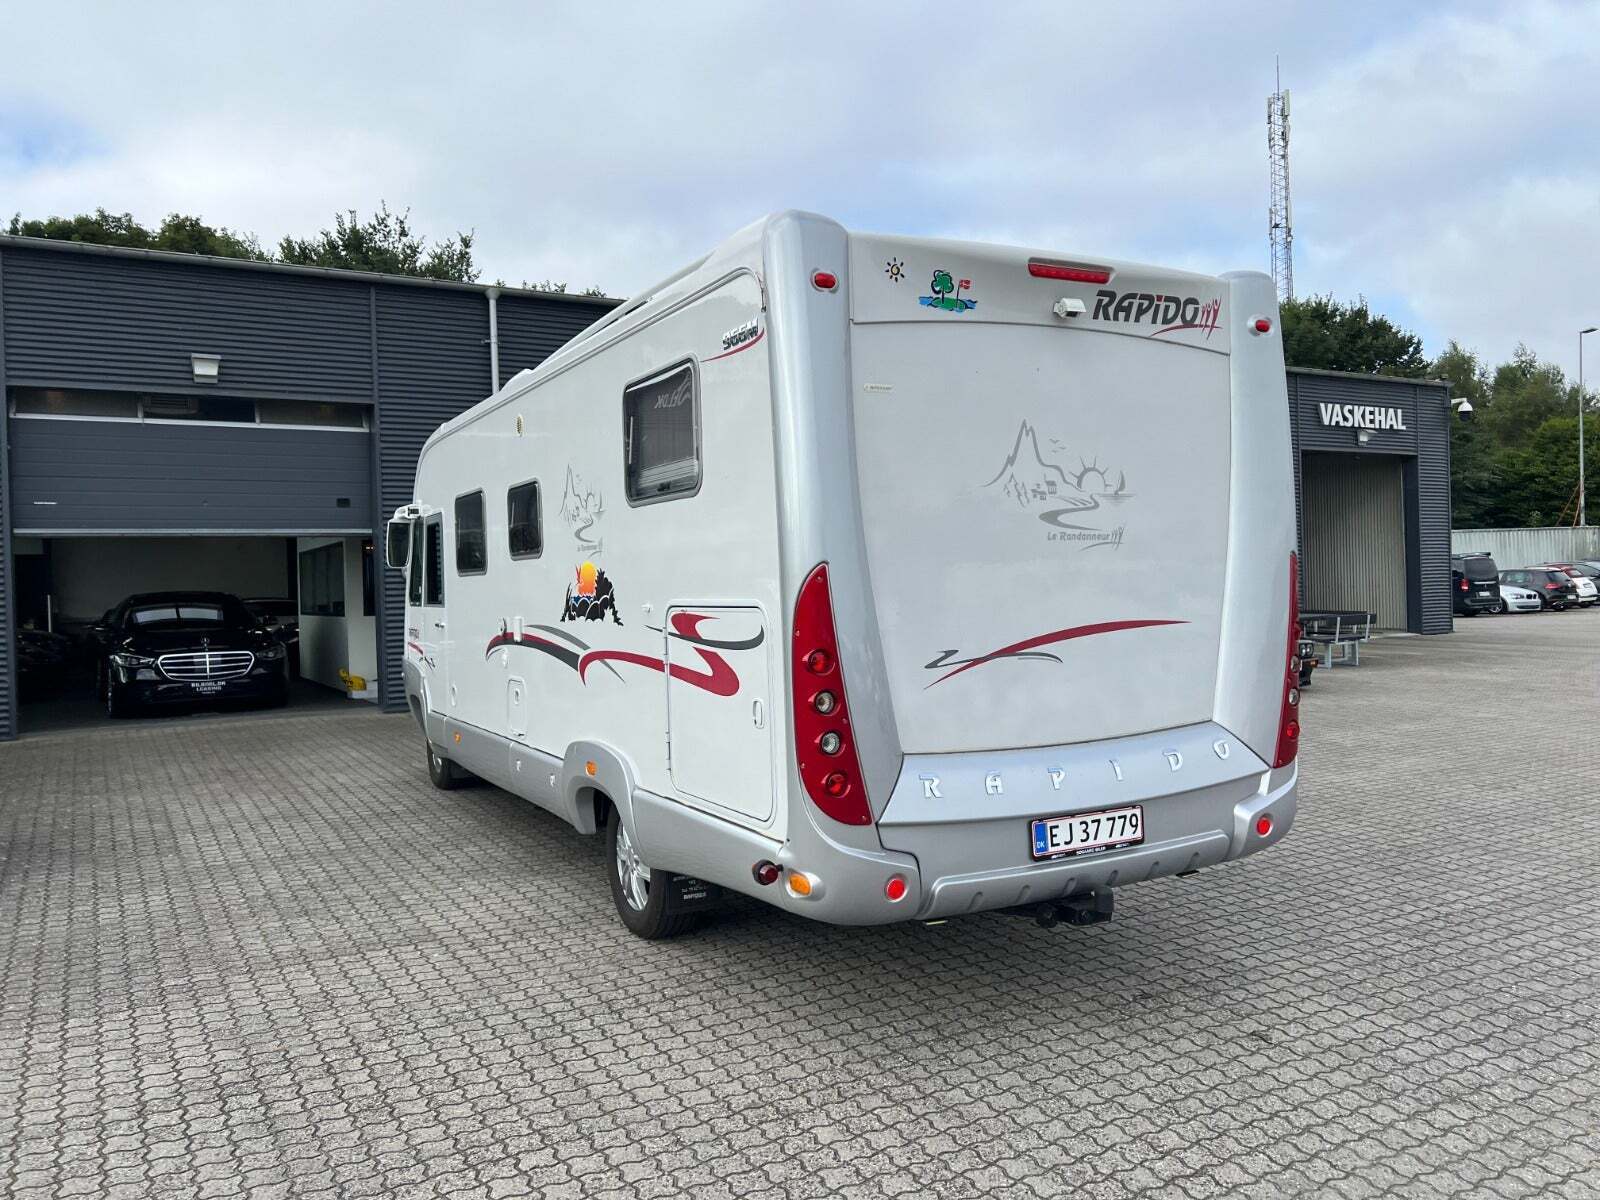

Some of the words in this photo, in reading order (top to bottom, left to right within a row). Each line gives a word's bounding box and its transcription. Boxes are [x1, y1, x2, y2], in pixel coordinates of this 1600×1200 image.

[1319, 402, 1407, 431] VASKEHAL
[1047, 531, 1057, 541] Le
[1059, 531, 1110, 541] Randonneur
[918, 739, 1231, 799] RAPIDO
[1049, 823, 1073, 847] EJ
[1079, 819, 1101, 842] 37
[1106, 813, 1138, 838] 779
[1036, 841, 1045, 849] DK
